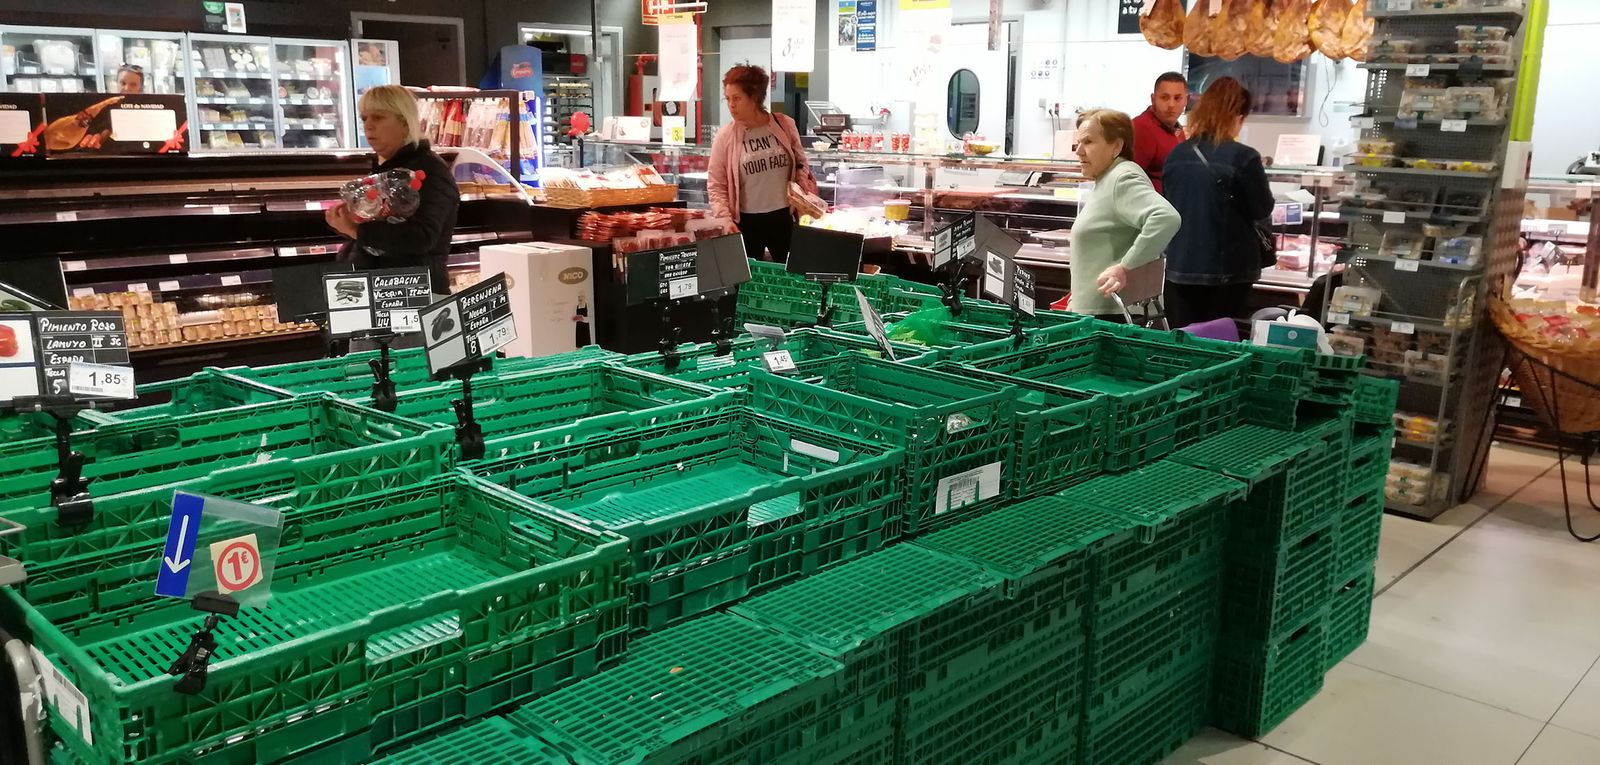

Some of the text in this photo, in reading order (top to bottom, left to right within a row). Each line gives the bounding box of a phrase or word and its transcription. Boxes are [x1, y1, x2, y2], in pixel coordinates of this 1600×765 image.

[742, 140, 748, 153] I
[742, 158, 768, 175] YOUR
[374, 276, 420, 287] CALABACIN
[563, 272, 584, 281] NICO
[461, 283, 502, 309] BERENJENA
[40, 318, 116, 332] PIMIENTO ROJO
[46, 340, 87, 350] LAMUYO
[470, 340, 477, 354] 8
[52, 379, 63, 395] 5
